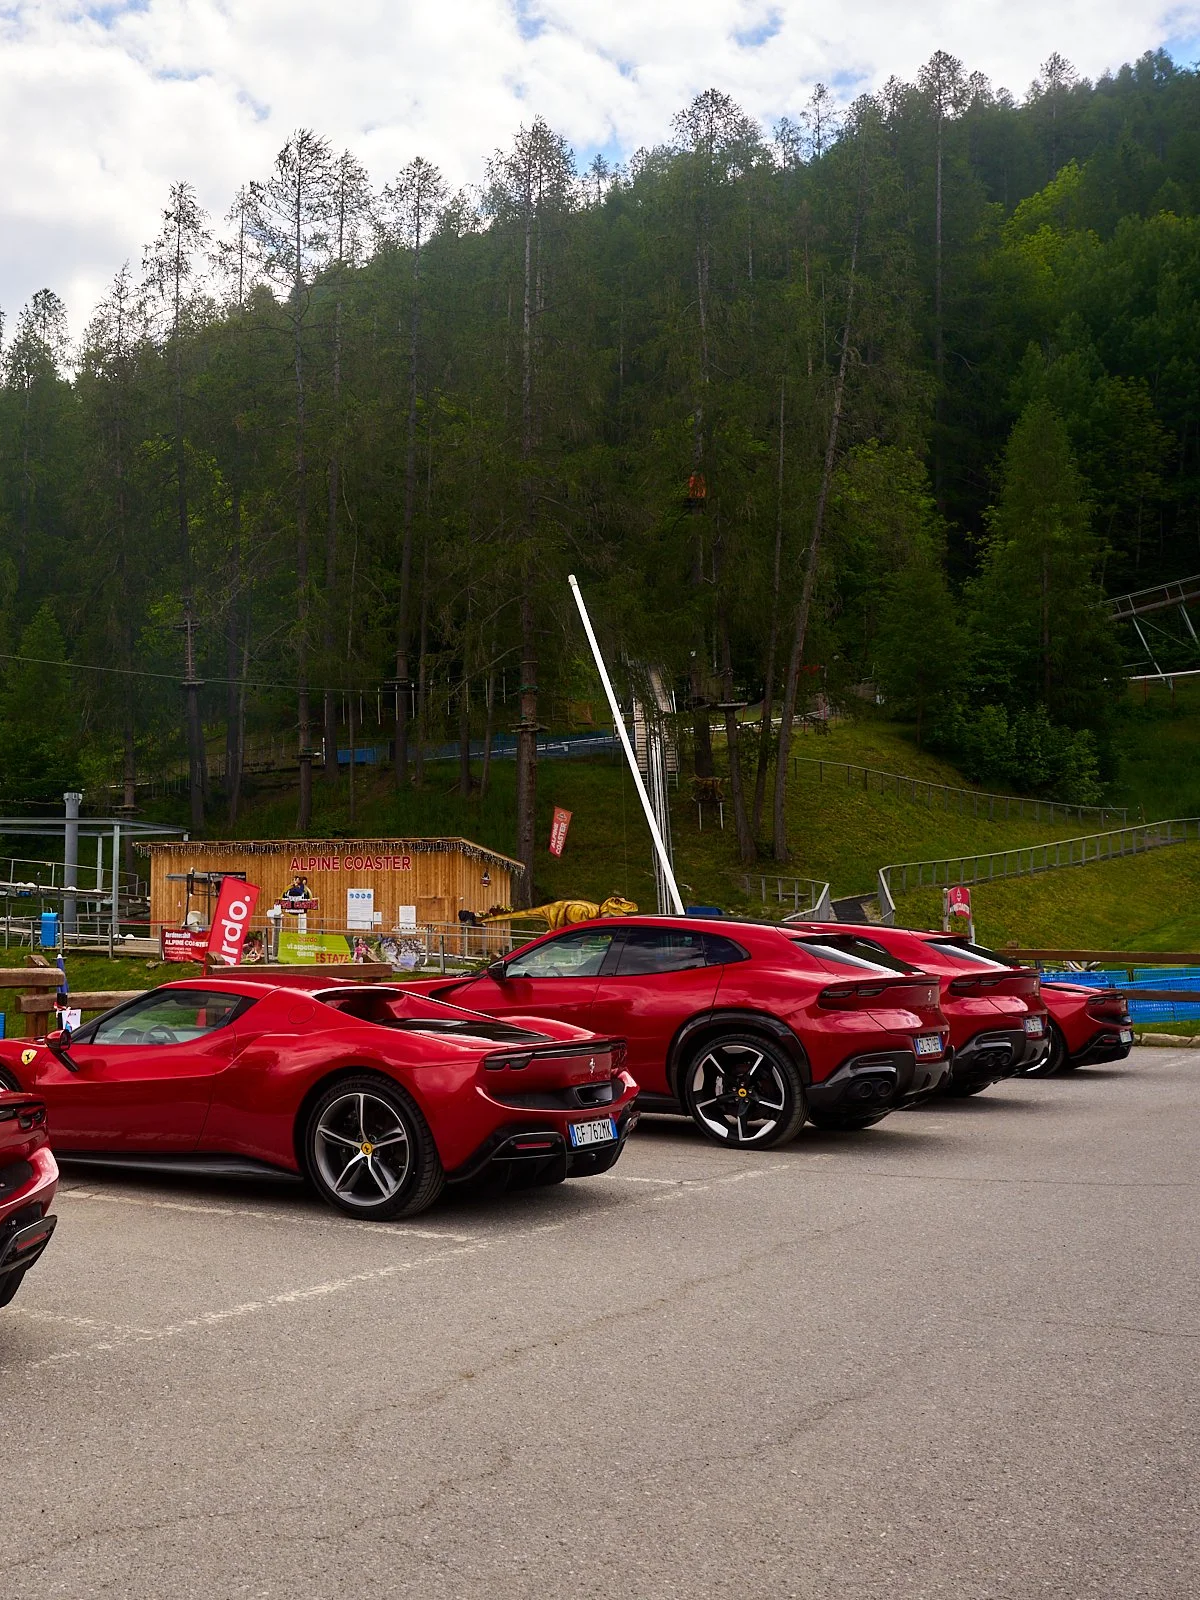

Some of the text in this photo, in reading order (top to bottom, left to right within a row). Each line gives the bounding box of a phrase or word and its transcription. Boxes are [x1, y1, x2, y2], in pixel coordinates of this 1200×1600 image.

[550, 822, 559, 850] ALPINE
[555, 822, 568, 855] COASTER
[290, 855, 412, 871] ALPINE COASTER
[220, 894, 252, 966] ardo.
[292, 944, 327, 952] aspettiamo
[315, 952, 349, 964] ESTATE
[588, 1121, 612, 1140] 762MK
